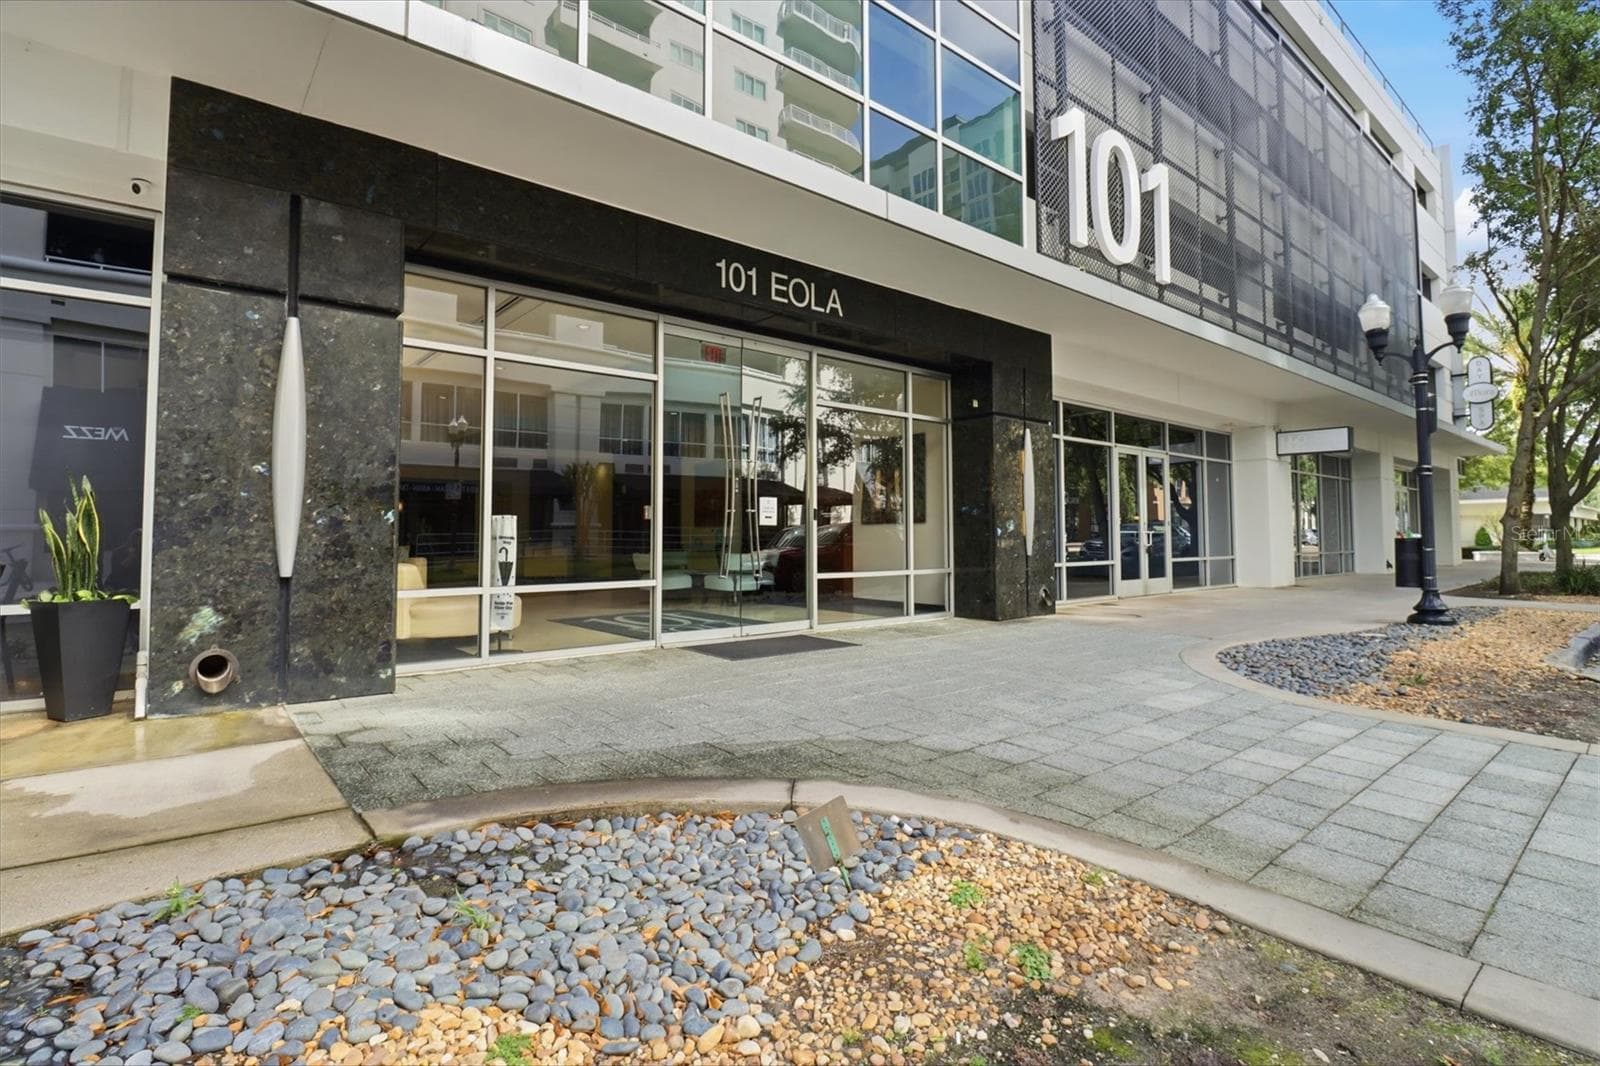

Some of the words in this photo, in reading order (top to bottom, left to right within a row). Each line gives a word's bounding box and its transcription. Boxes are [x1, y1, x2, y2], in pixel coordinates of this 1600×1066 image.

[1050, 107, 1171, 285] 101
[715, 258, 757, 296] 101
[771, 271, 844, 317] EOLA
